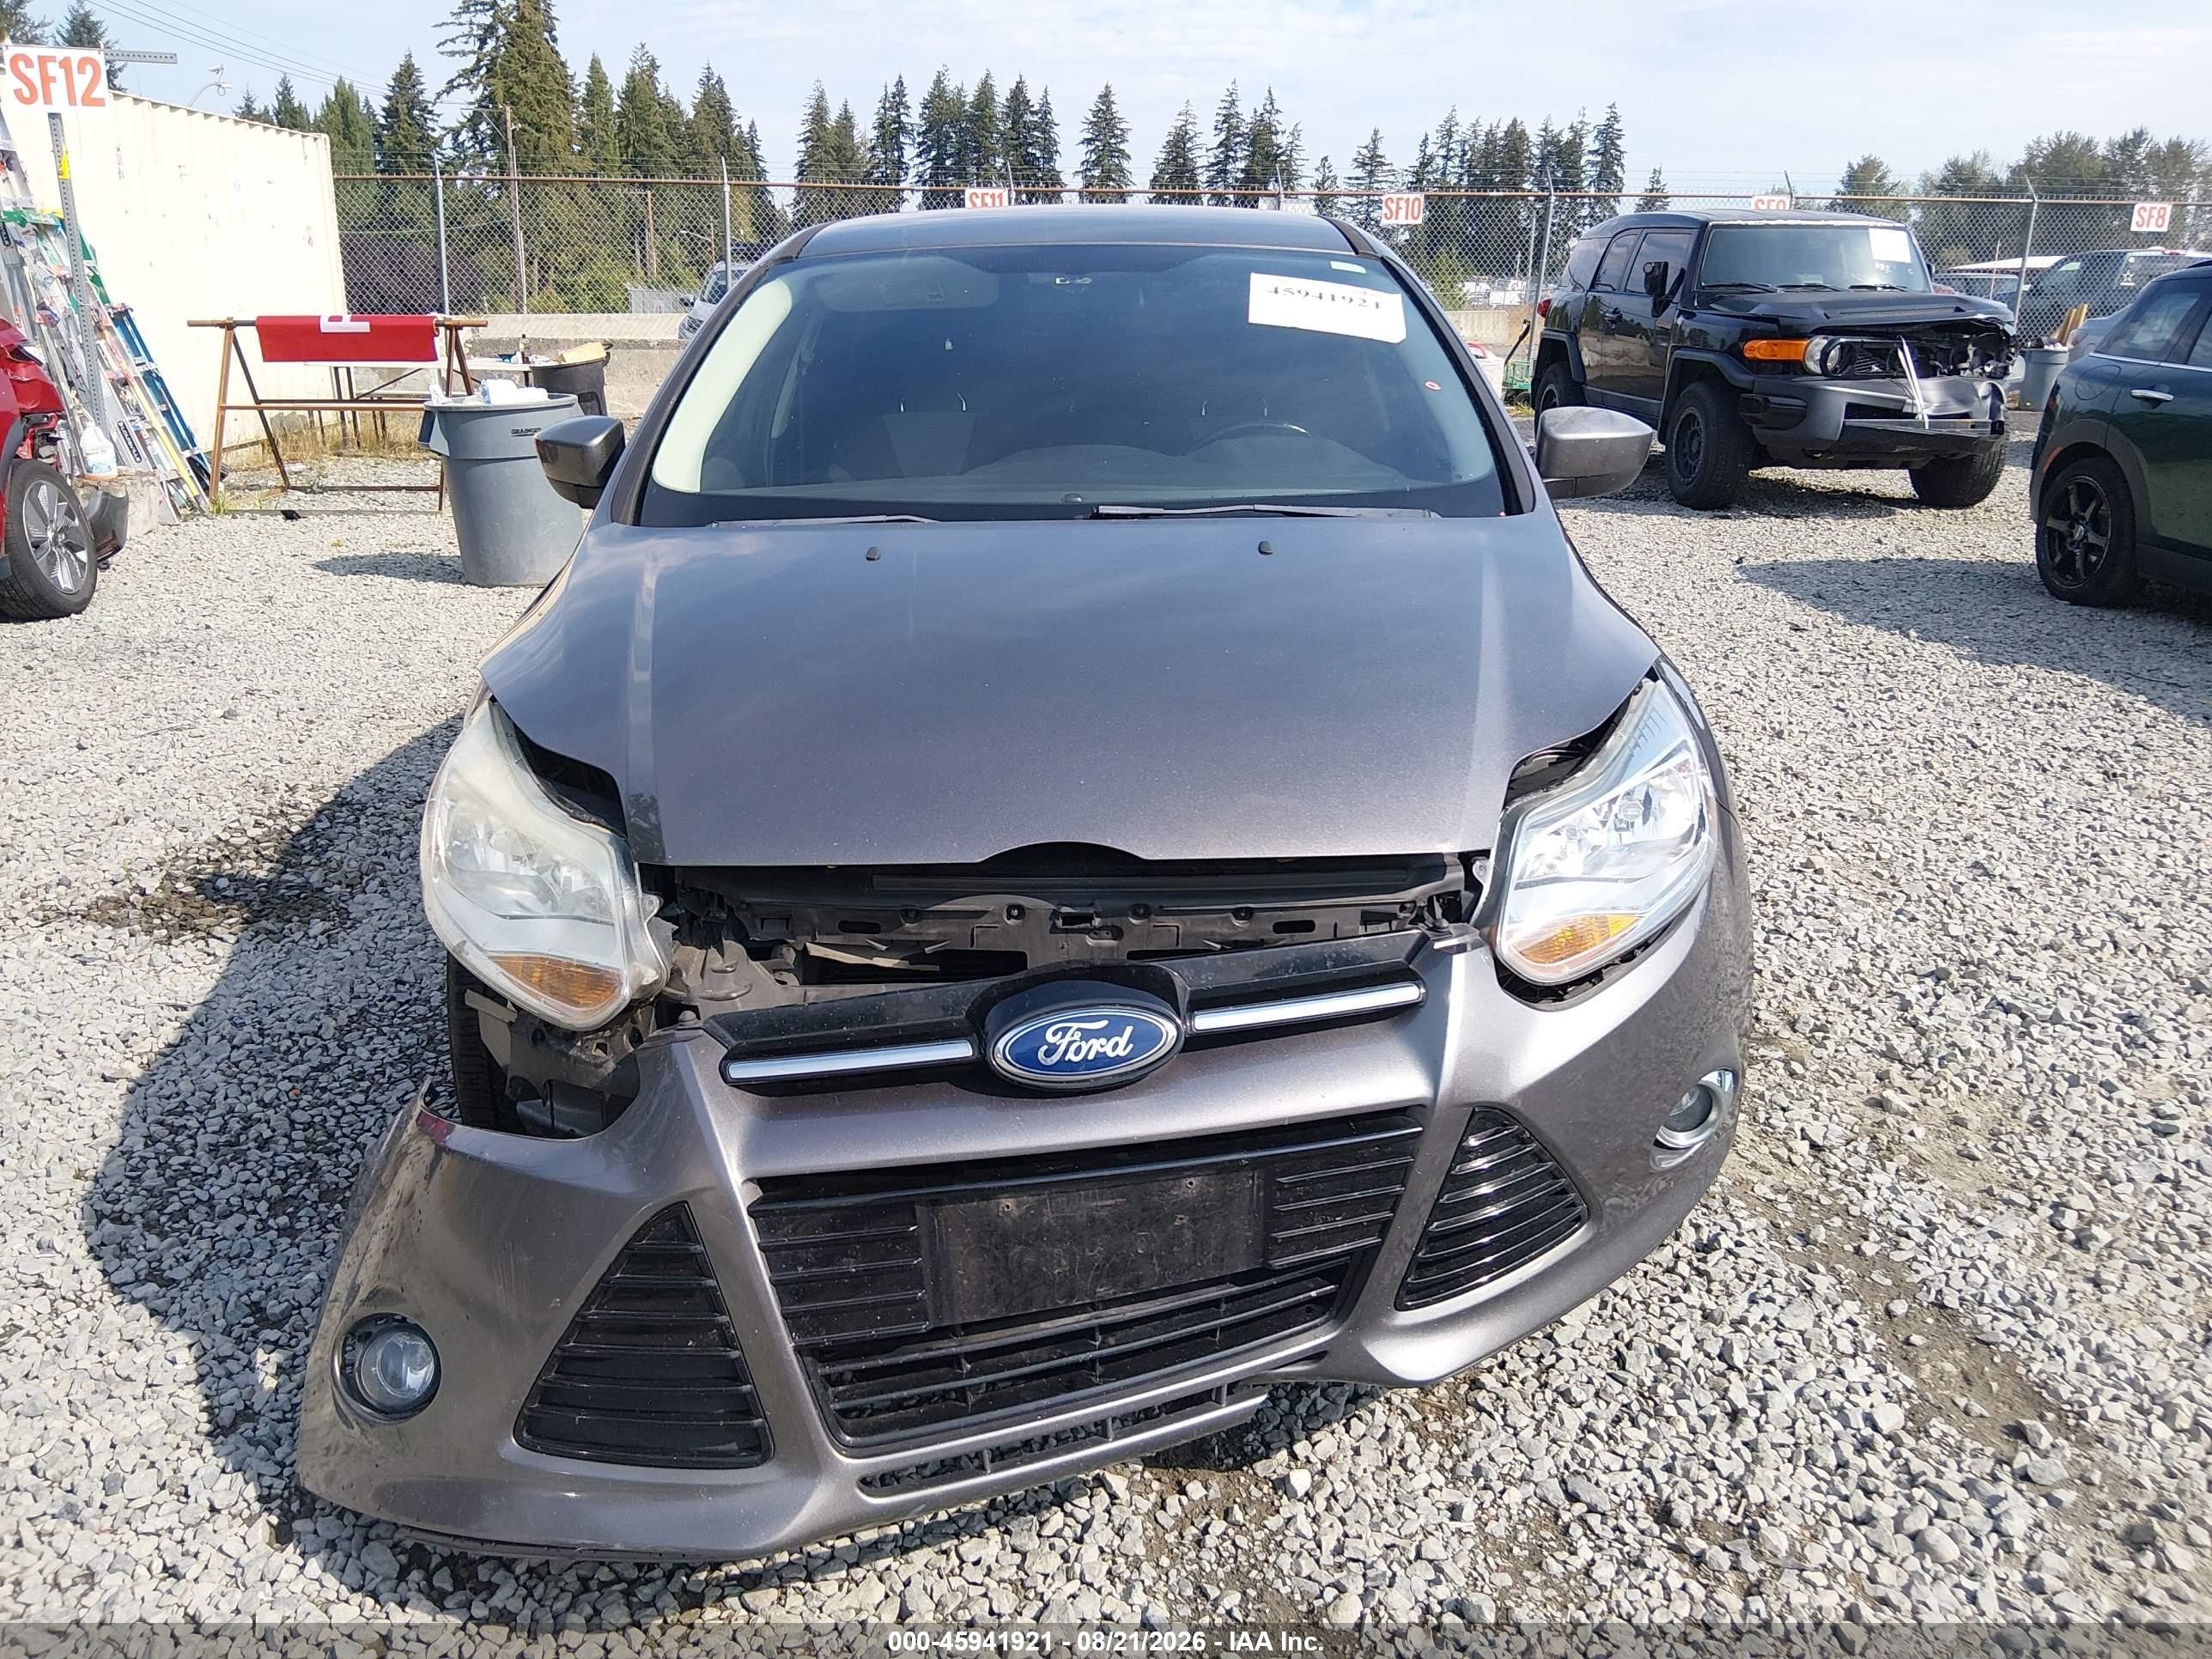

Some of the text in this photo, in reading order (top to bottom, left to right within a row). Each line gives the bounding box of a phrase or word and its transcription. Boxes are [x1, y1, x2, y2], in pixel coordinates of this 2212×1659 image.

[9, 52, 106, 107] SF12
[1383, 197, 1422, 221] SF10
[2135, 205, 2167, 228] SF8
[1037, 1019, 1134, 1066] Ford
